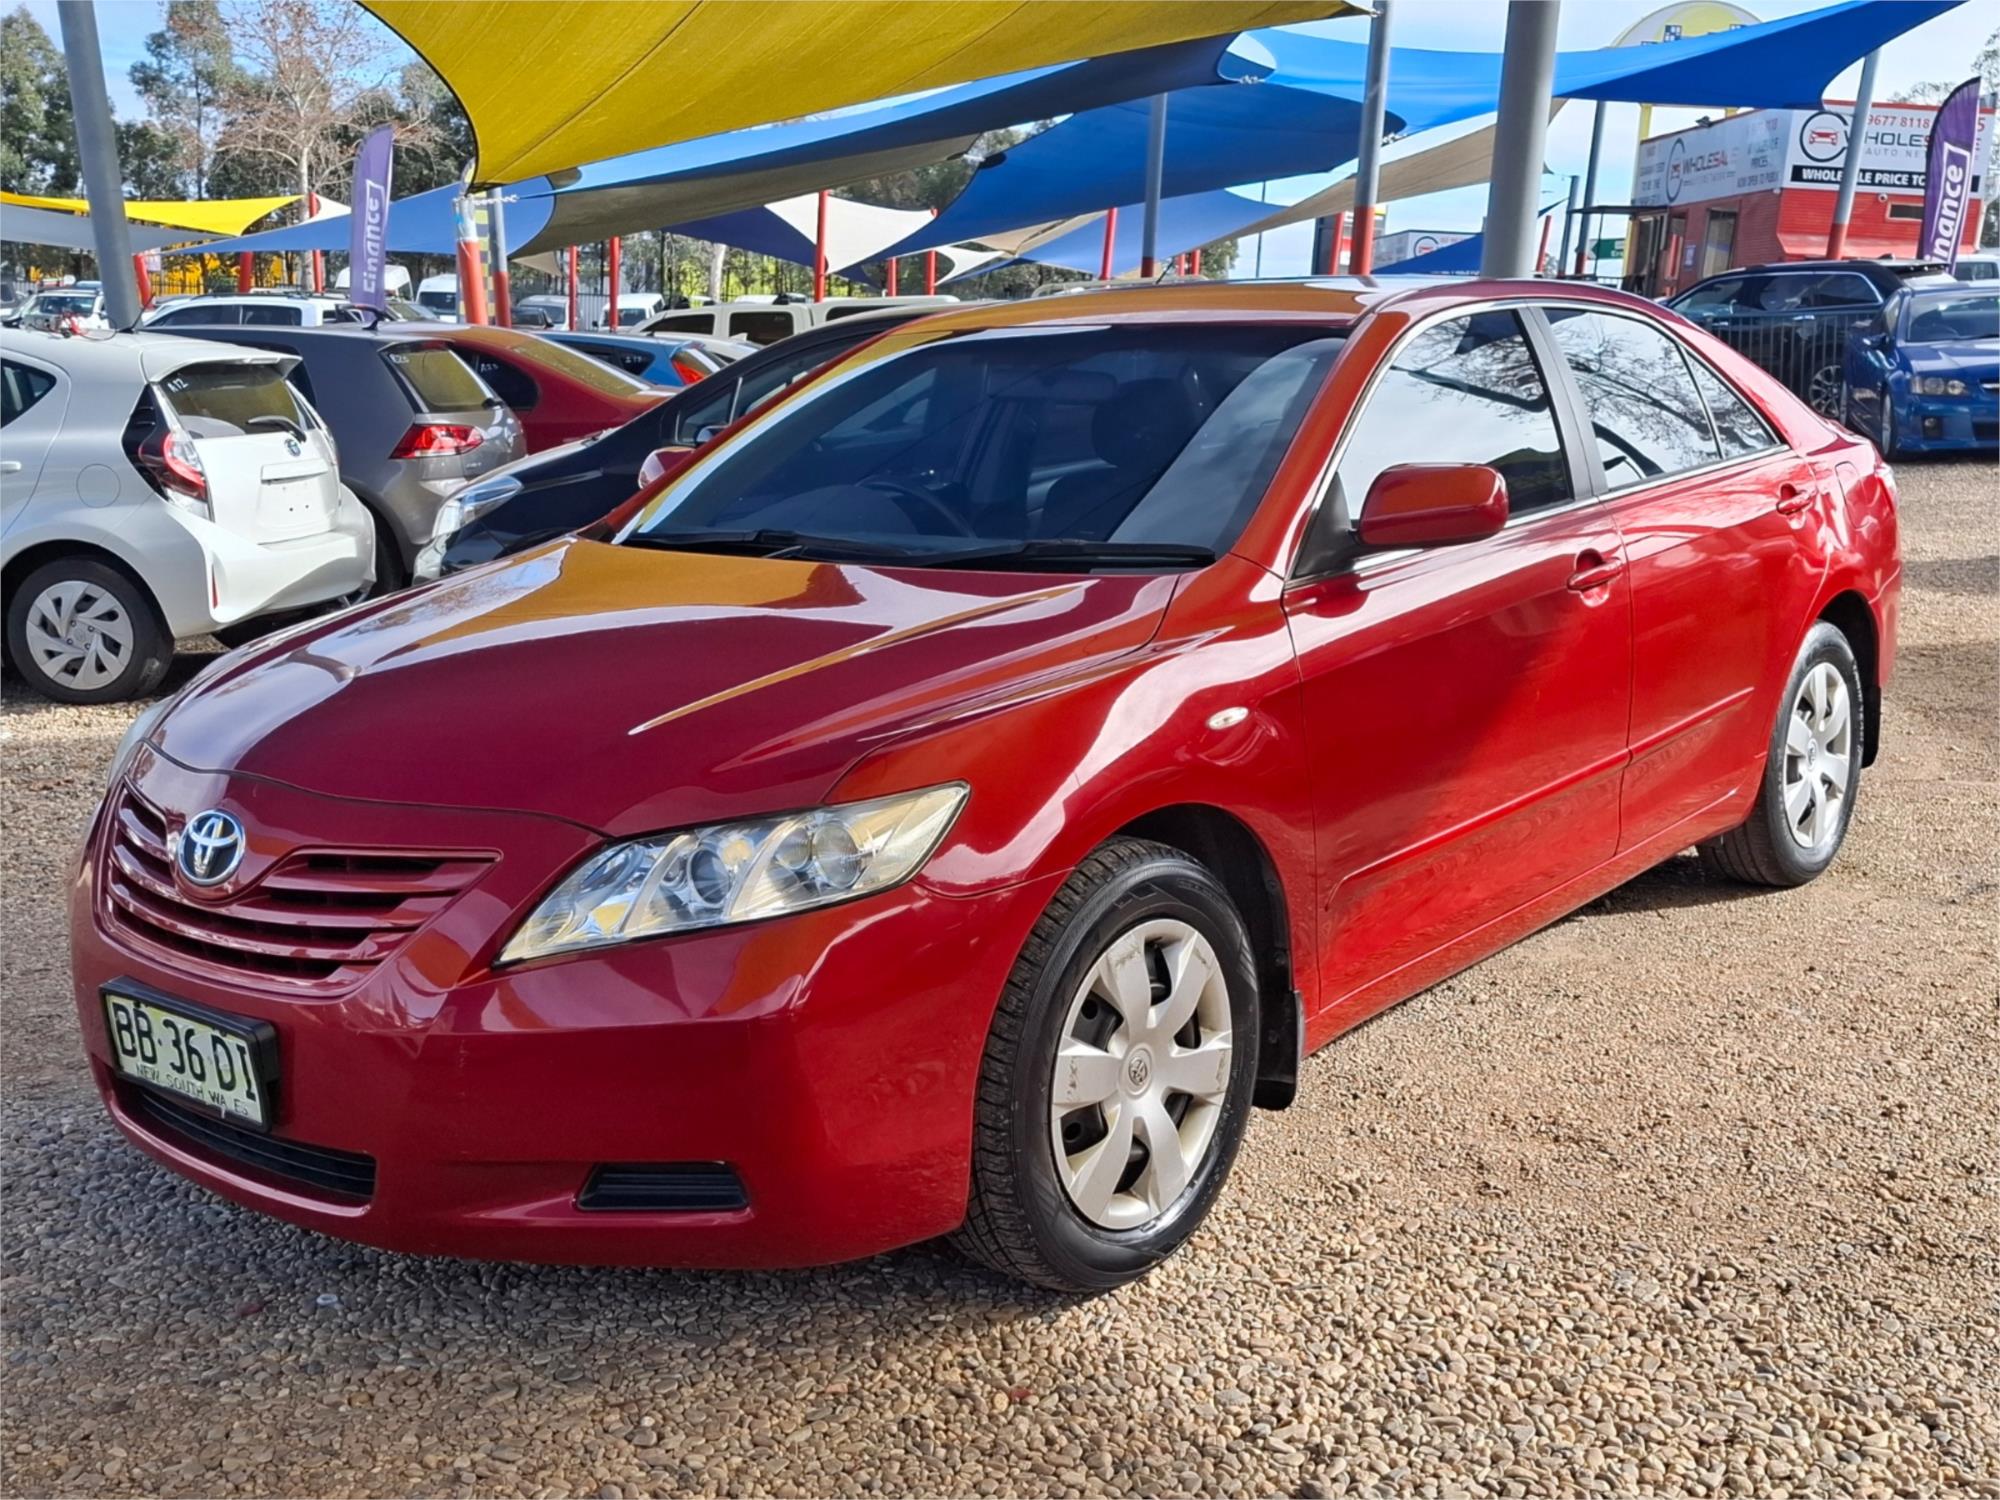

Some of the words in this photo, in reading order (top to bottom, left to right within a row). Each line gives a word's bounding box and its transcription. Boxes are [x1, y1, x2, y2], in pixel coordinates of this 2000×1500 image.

[1900, 116, 1930, 129] 8118
[1875, 172, 1909, 186] PRICE
[166, 1074, 204, 1098] SOUTH
